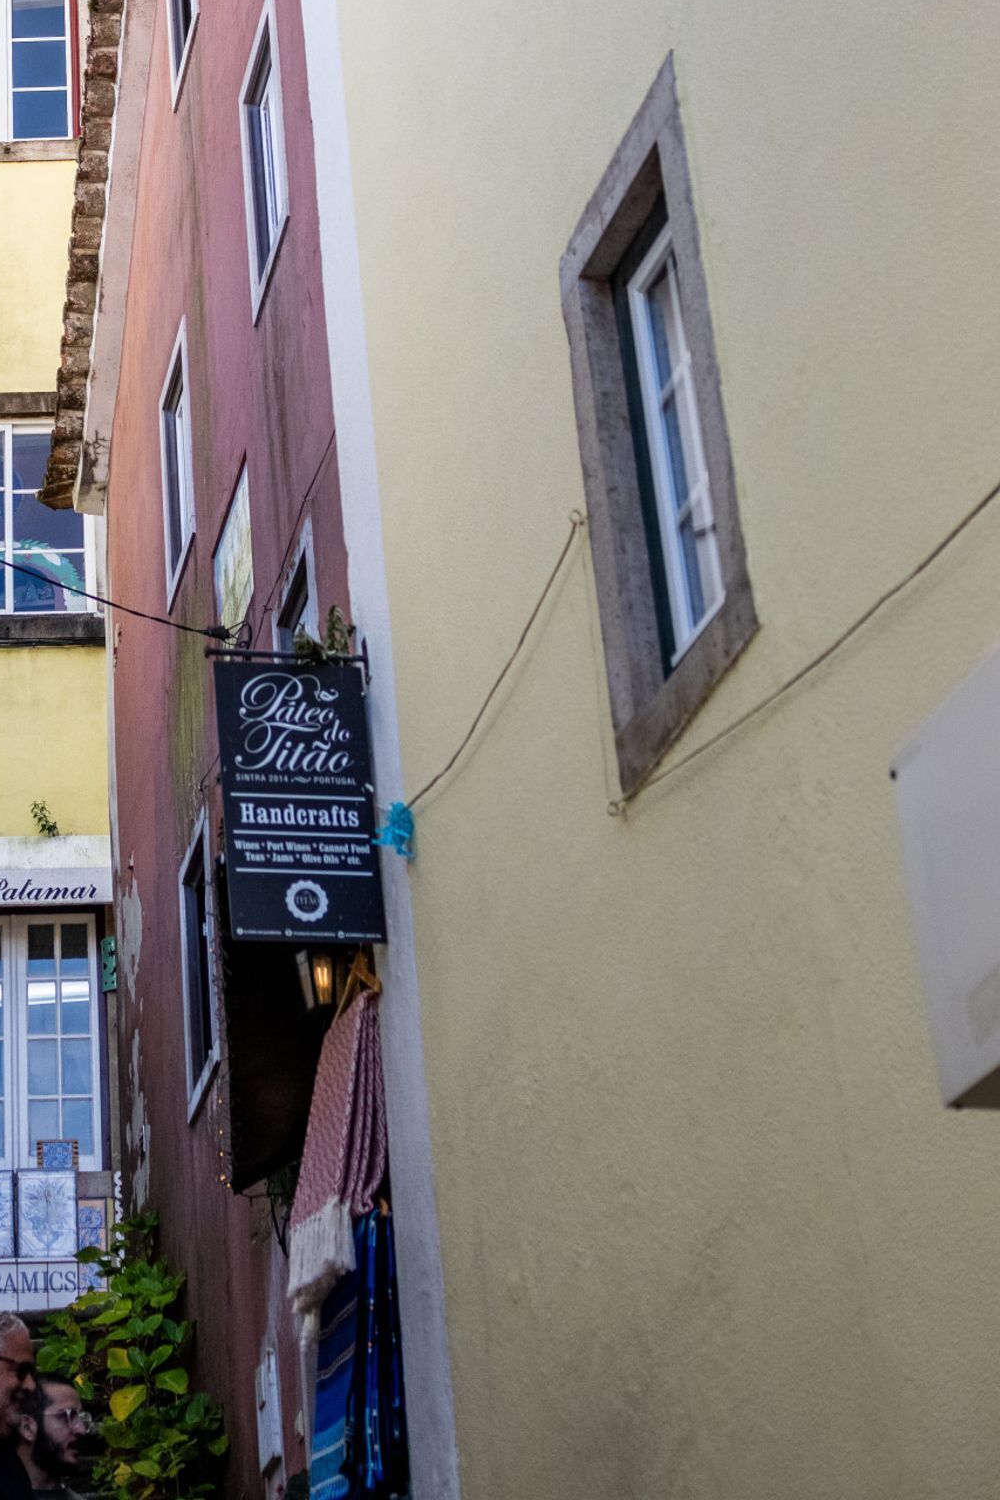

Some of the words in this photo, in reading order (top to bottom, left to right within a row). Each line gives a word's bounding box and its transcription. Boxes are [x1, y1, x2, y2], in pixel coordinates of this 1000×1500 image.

[239, 672, 335, 724] Páteo
[323, 719, 351, 742] do
[235, 720, 354, 773] Titão
[235, 773, 267, 782] SINTRA
[269, 774, 288, 783] 2014
[313, 776, 357, 786] PORTUGAL
[240, 803, 360, 828] Handcrafts
[234, 840, 260, 850] Wines
[267, 841, 284, 851] Port
[285, 841, 311, 852] Wines
[319, 842, 349, 853] Canned
[351, 843, 370, 854] Food
[245, 852, 266, 862] Teas
[272, 852, 294, 863] Jams
[302, 853, 321, 864] Olive
[323, 854, 340, 864] Oils
